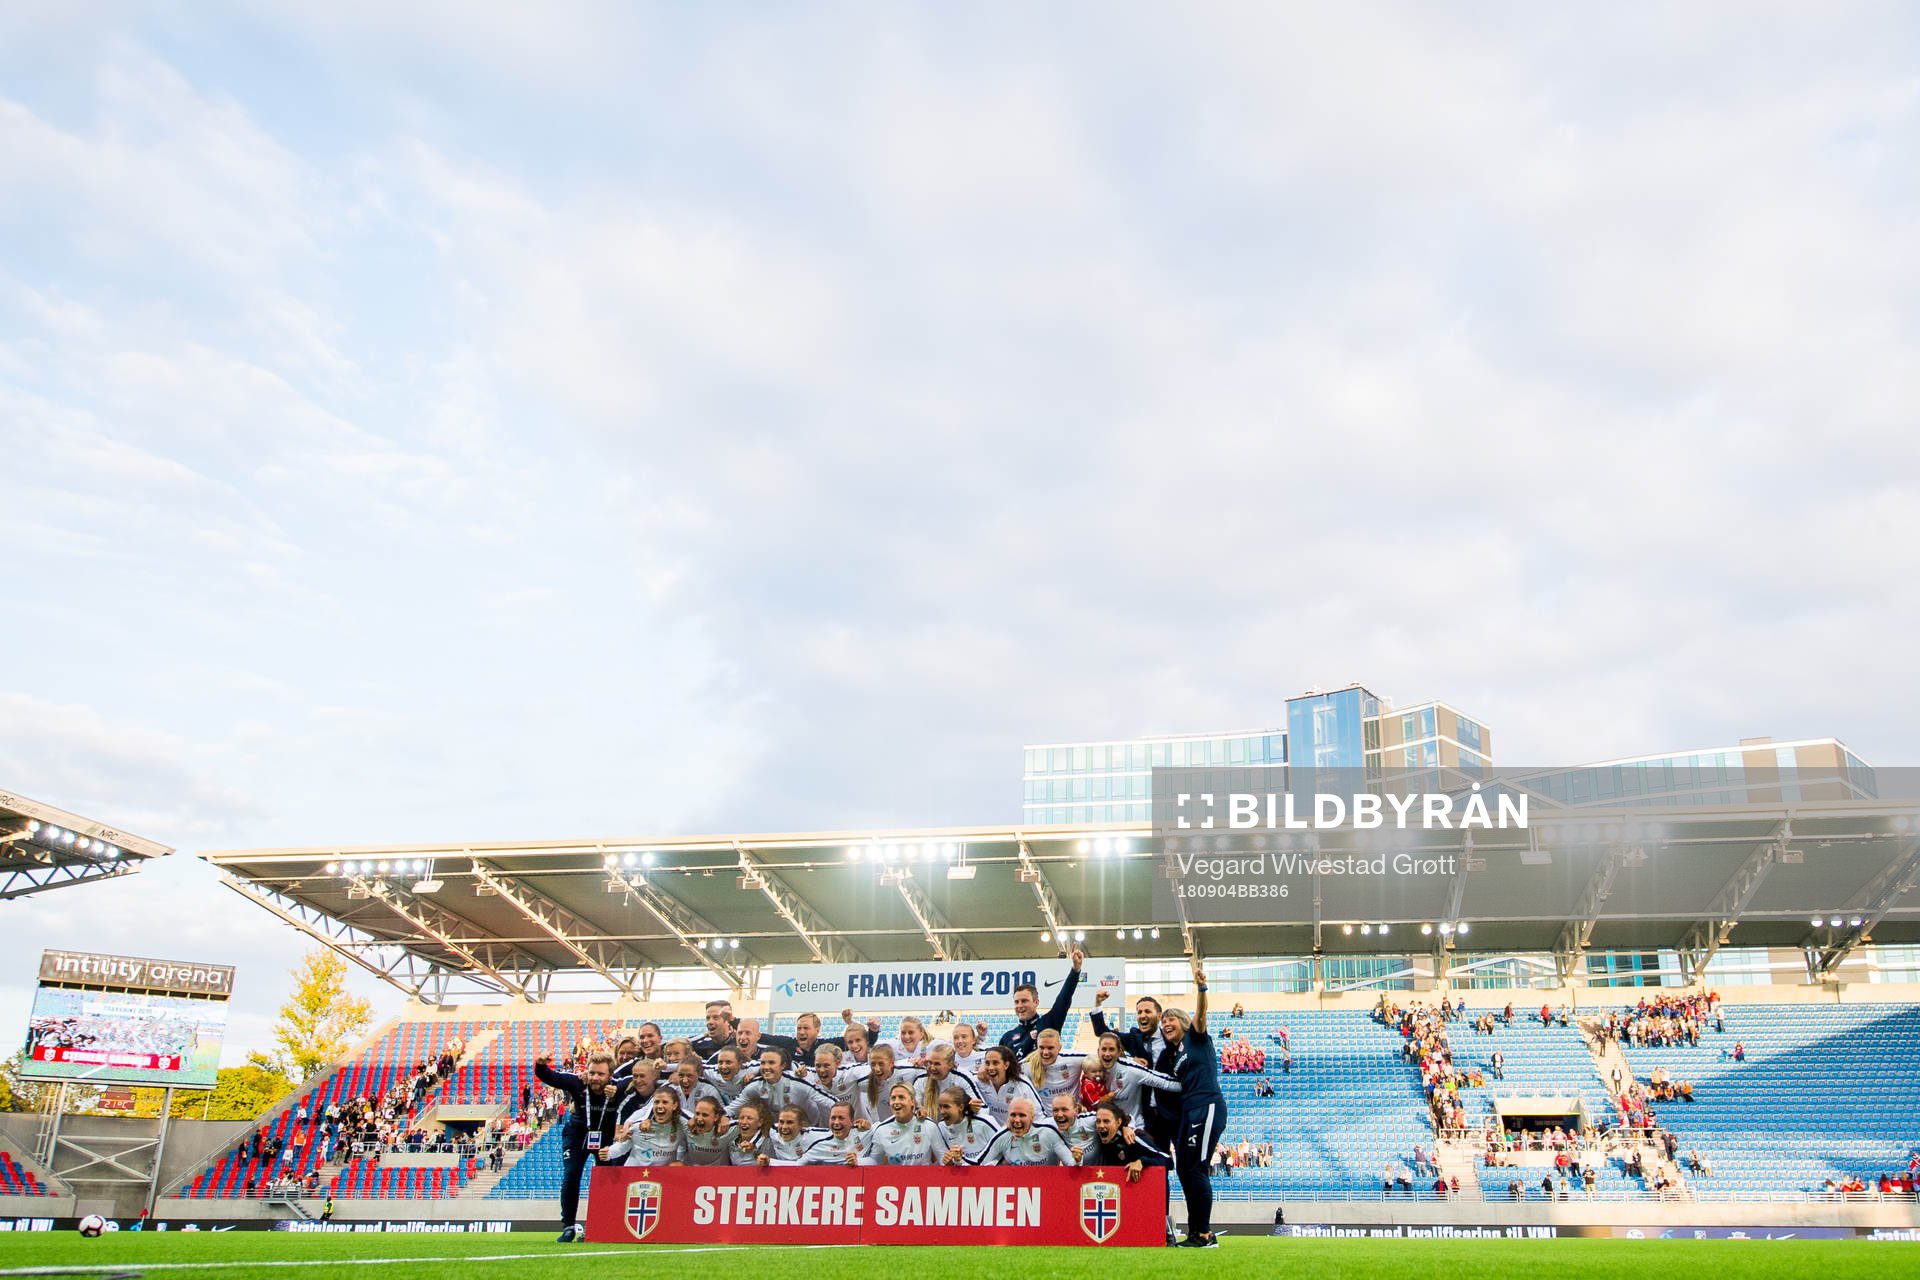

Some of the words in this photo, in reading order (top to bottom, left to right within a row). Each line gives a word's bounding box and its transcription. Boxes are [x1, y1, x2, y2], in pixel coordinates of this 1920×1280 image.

[99, 829, 118, 841] NRC
[55, 954, 143, 982] intility
[151, 965, 222, 985] arena
[794, 980, 840, 993] telenor
[848, 972, 973, 998] FRANKRIKE
[981, 970, 1036, 995] 2019
[693, 1186, 863, 1226] STERKERE
[875, 1186, 1041, 1227] SAMMEN
[468, 1221, 483, 1232] til
[1506, 1226, 1522, 1238] til
